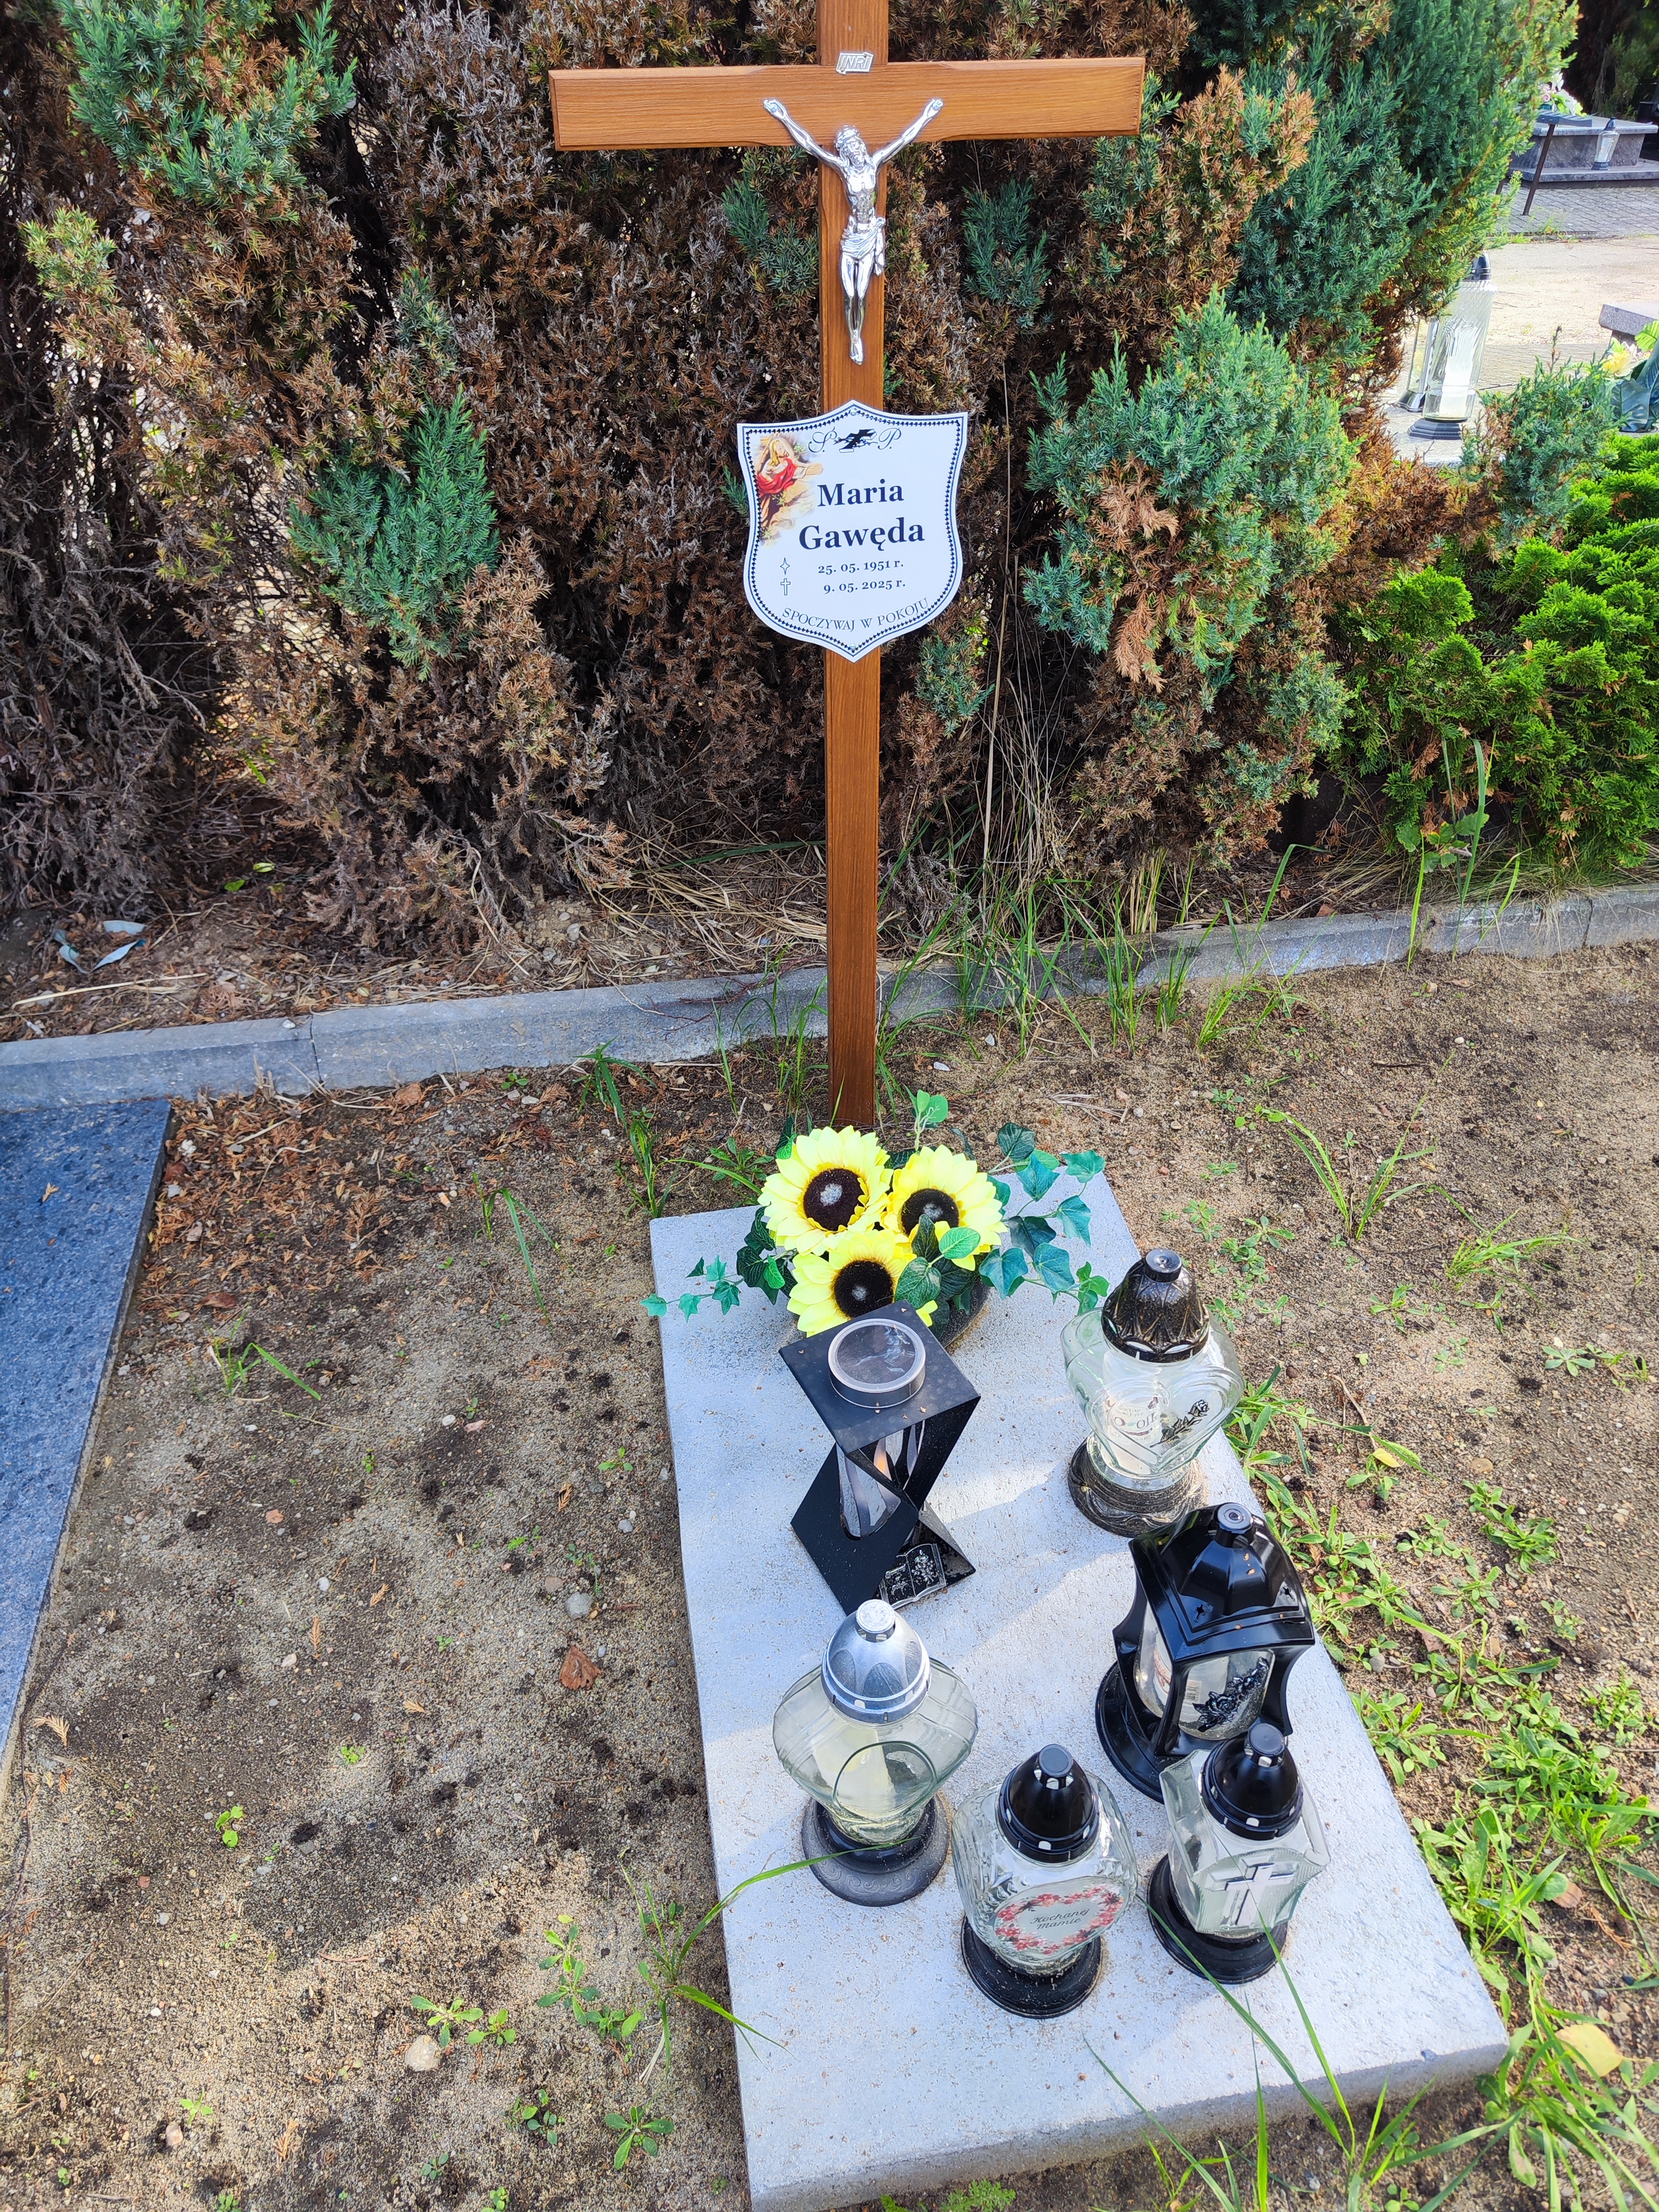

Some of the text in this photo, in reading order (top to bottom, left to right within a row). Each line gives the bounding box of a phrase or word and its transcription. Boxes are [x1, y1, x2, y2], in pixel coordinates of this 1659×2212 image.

[840, 55, 869, 69] INRI
[817, 478, 905, 507] Maria
[799, 517, 925, 551] Gawęda
[818, 565, 837, 575] 25.
[841, 563, 860, 573] 05.
[864, 560, 891, 571] 1951
[824, 584, 835, 595] 9.
[839, 583, 858, 592] 05.
[862, 580, 892, 590] 2025
[782, 597, 928, 632] SPOCZYWAJ W POKOJU
[1030, 1908, 1090, 1924] Kochanej
